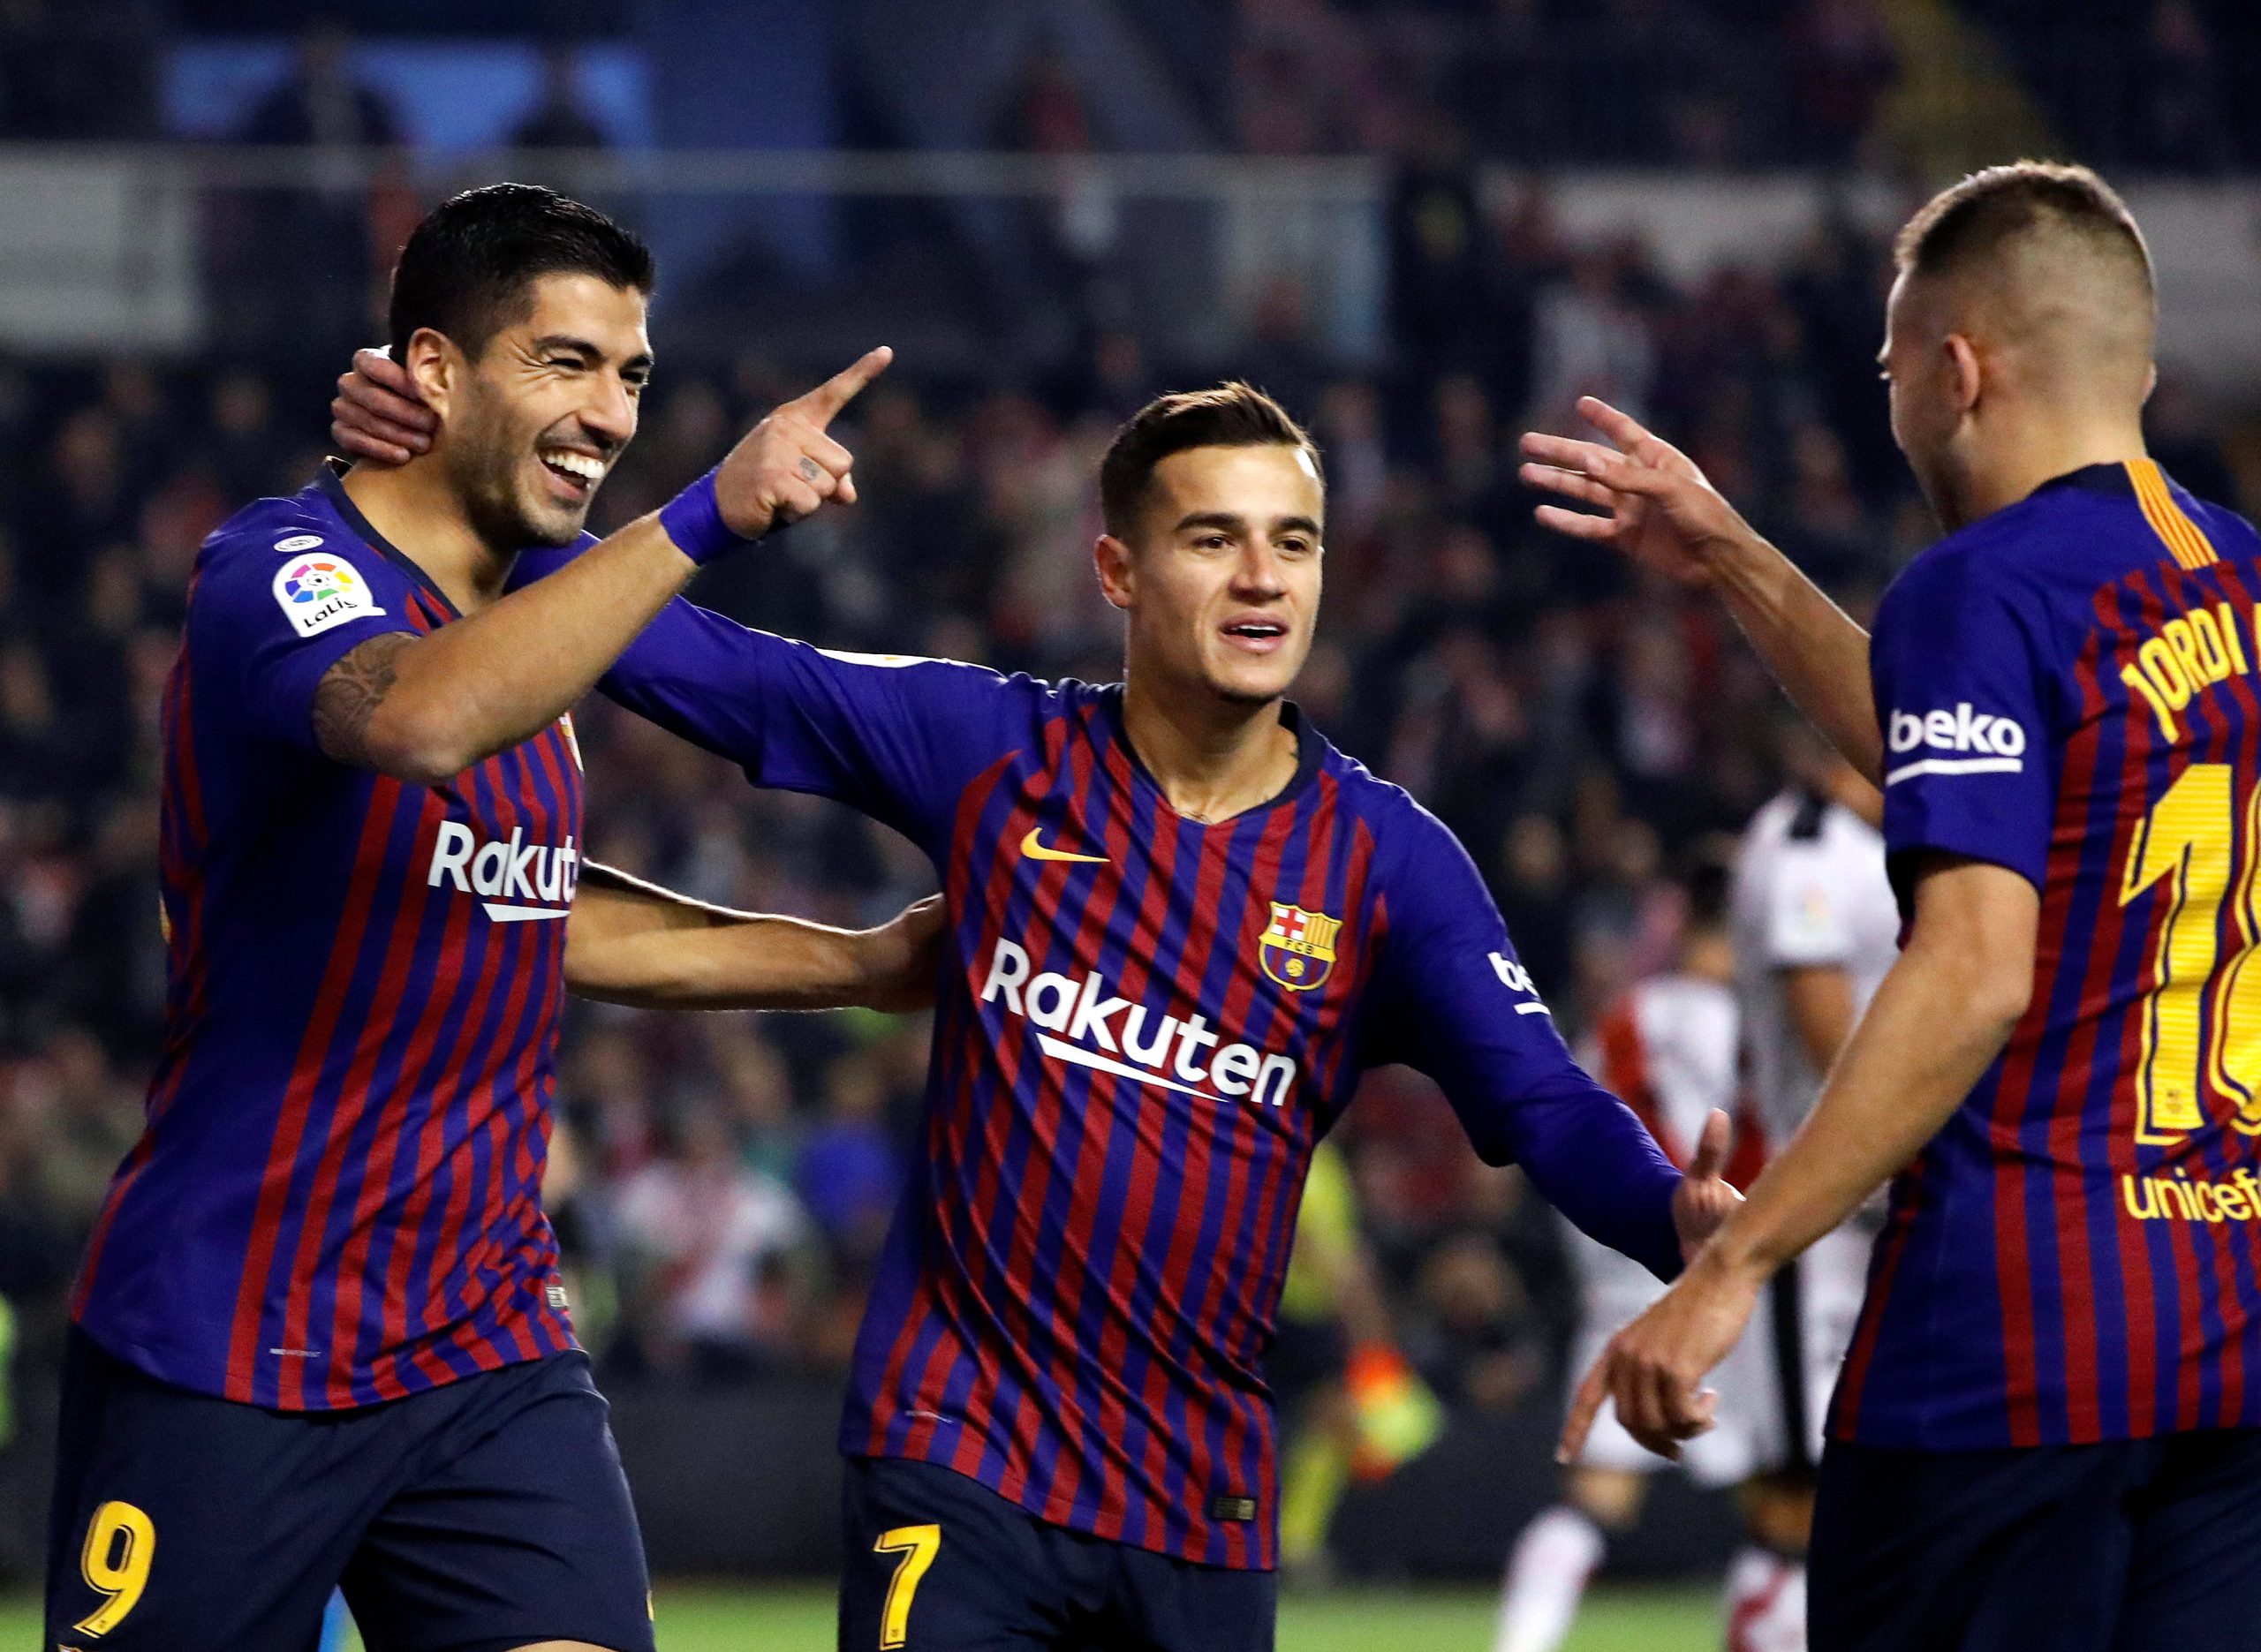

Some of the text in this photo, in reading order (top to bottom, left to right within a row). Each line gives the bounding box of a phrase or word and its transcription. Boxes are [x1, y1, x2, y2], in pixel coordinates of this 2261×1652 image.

[2121, 601, 2249, 744] JORDI
[1888, 703, 2025, 757] beko
[427, 820, 579, 902] Rakut
[1284, 939, 1314, 955] FCB
[980, 937, 1297, 1106] Rakuten
[2122, 1166, 2261, 1223] unicef
[72, 1500, 156, 1639] 9
[873, 1523, 941, 1651] 7
